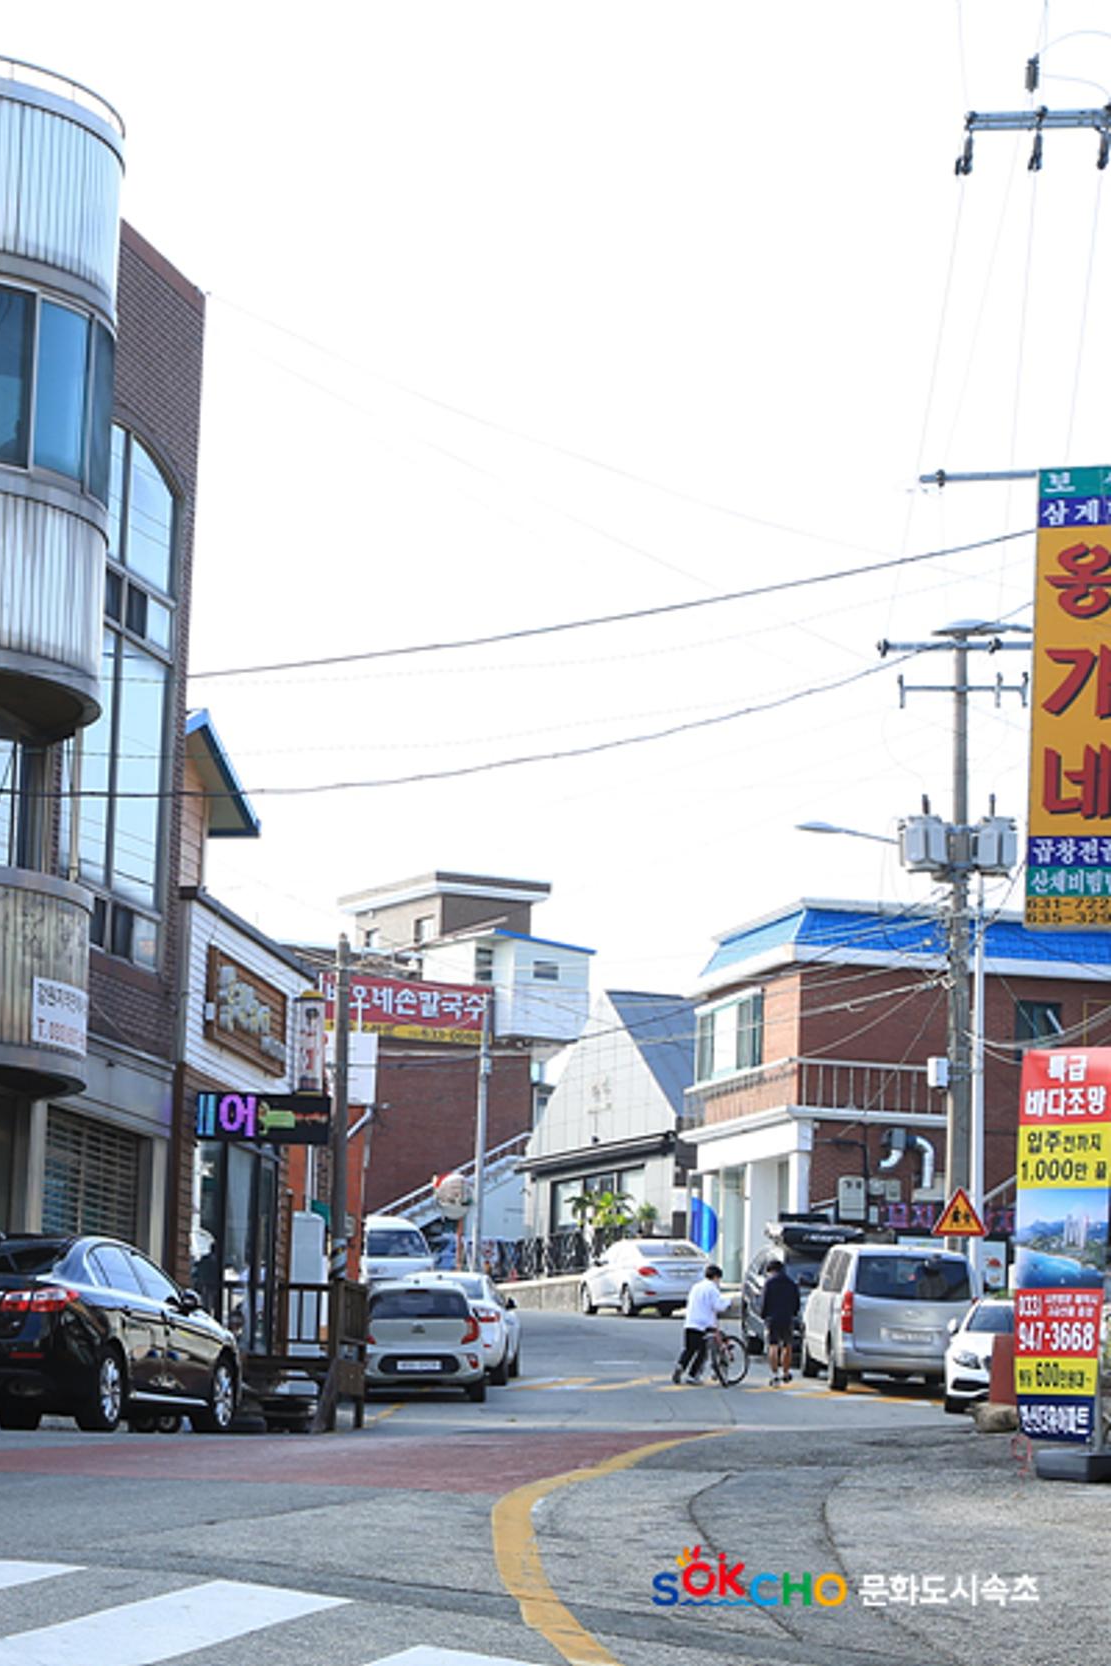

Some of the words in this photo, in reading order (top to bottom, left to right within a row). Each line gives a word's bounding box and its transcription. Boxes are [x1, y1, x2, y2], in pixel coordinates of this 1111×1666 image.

[1042, 498, 1111, 527] 삼계
[1025, 1085, 1107, 1117] 바다조망
[1018, 1321, 1096, 1352] 947-3668
